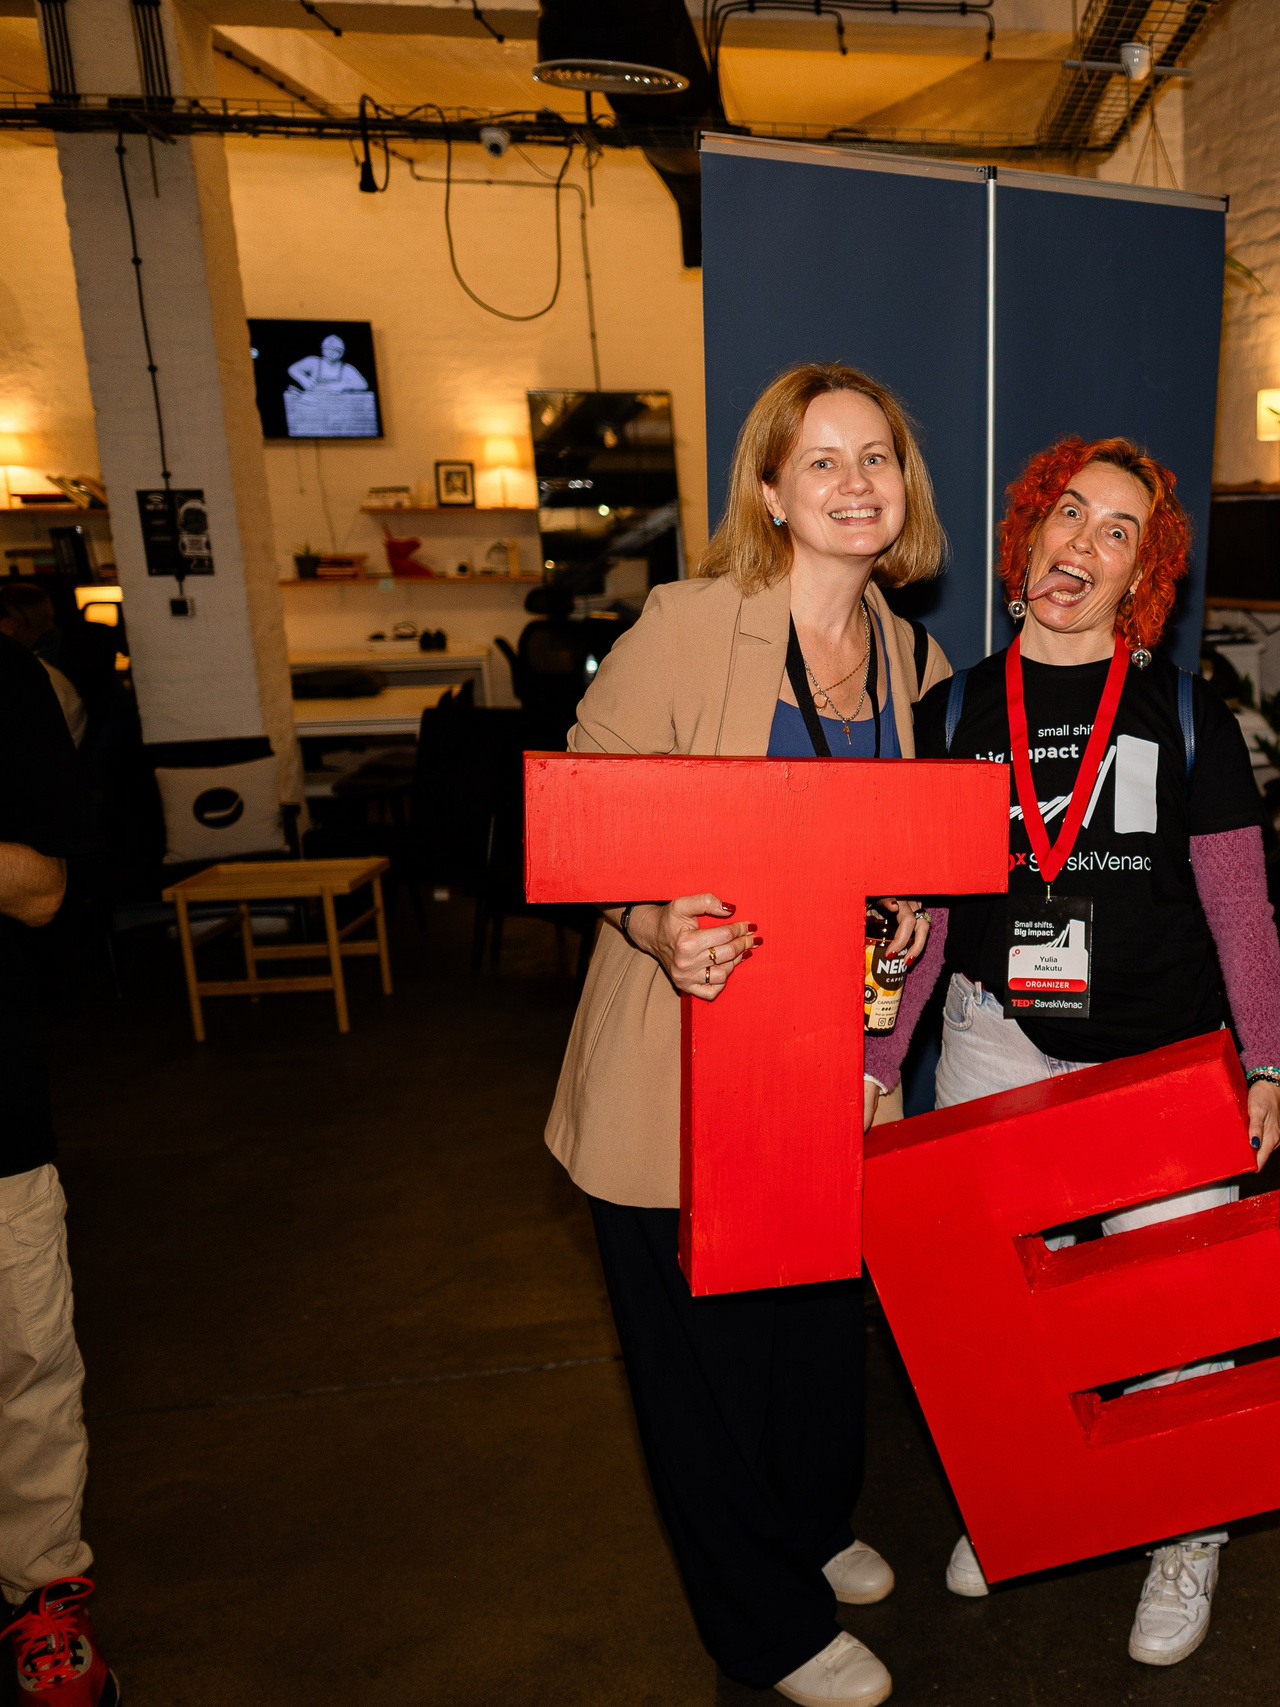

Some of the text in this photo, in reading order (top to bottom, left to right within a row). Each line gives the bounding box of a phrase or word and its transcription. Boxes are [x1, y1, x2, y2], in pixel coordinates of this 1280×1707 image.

[1037, 723, 1095, 738] small shif
[1010, 743, 1080, 764] ipact
[1014, 920, 1055, 929] Small shifts.
[1014, 928, 1027, 937] Big
[876, 958, 908, 975] NER
[1034, 964, 1063, 972] Makutu
[1025, 980, 1070, 989] ORGANIZER
